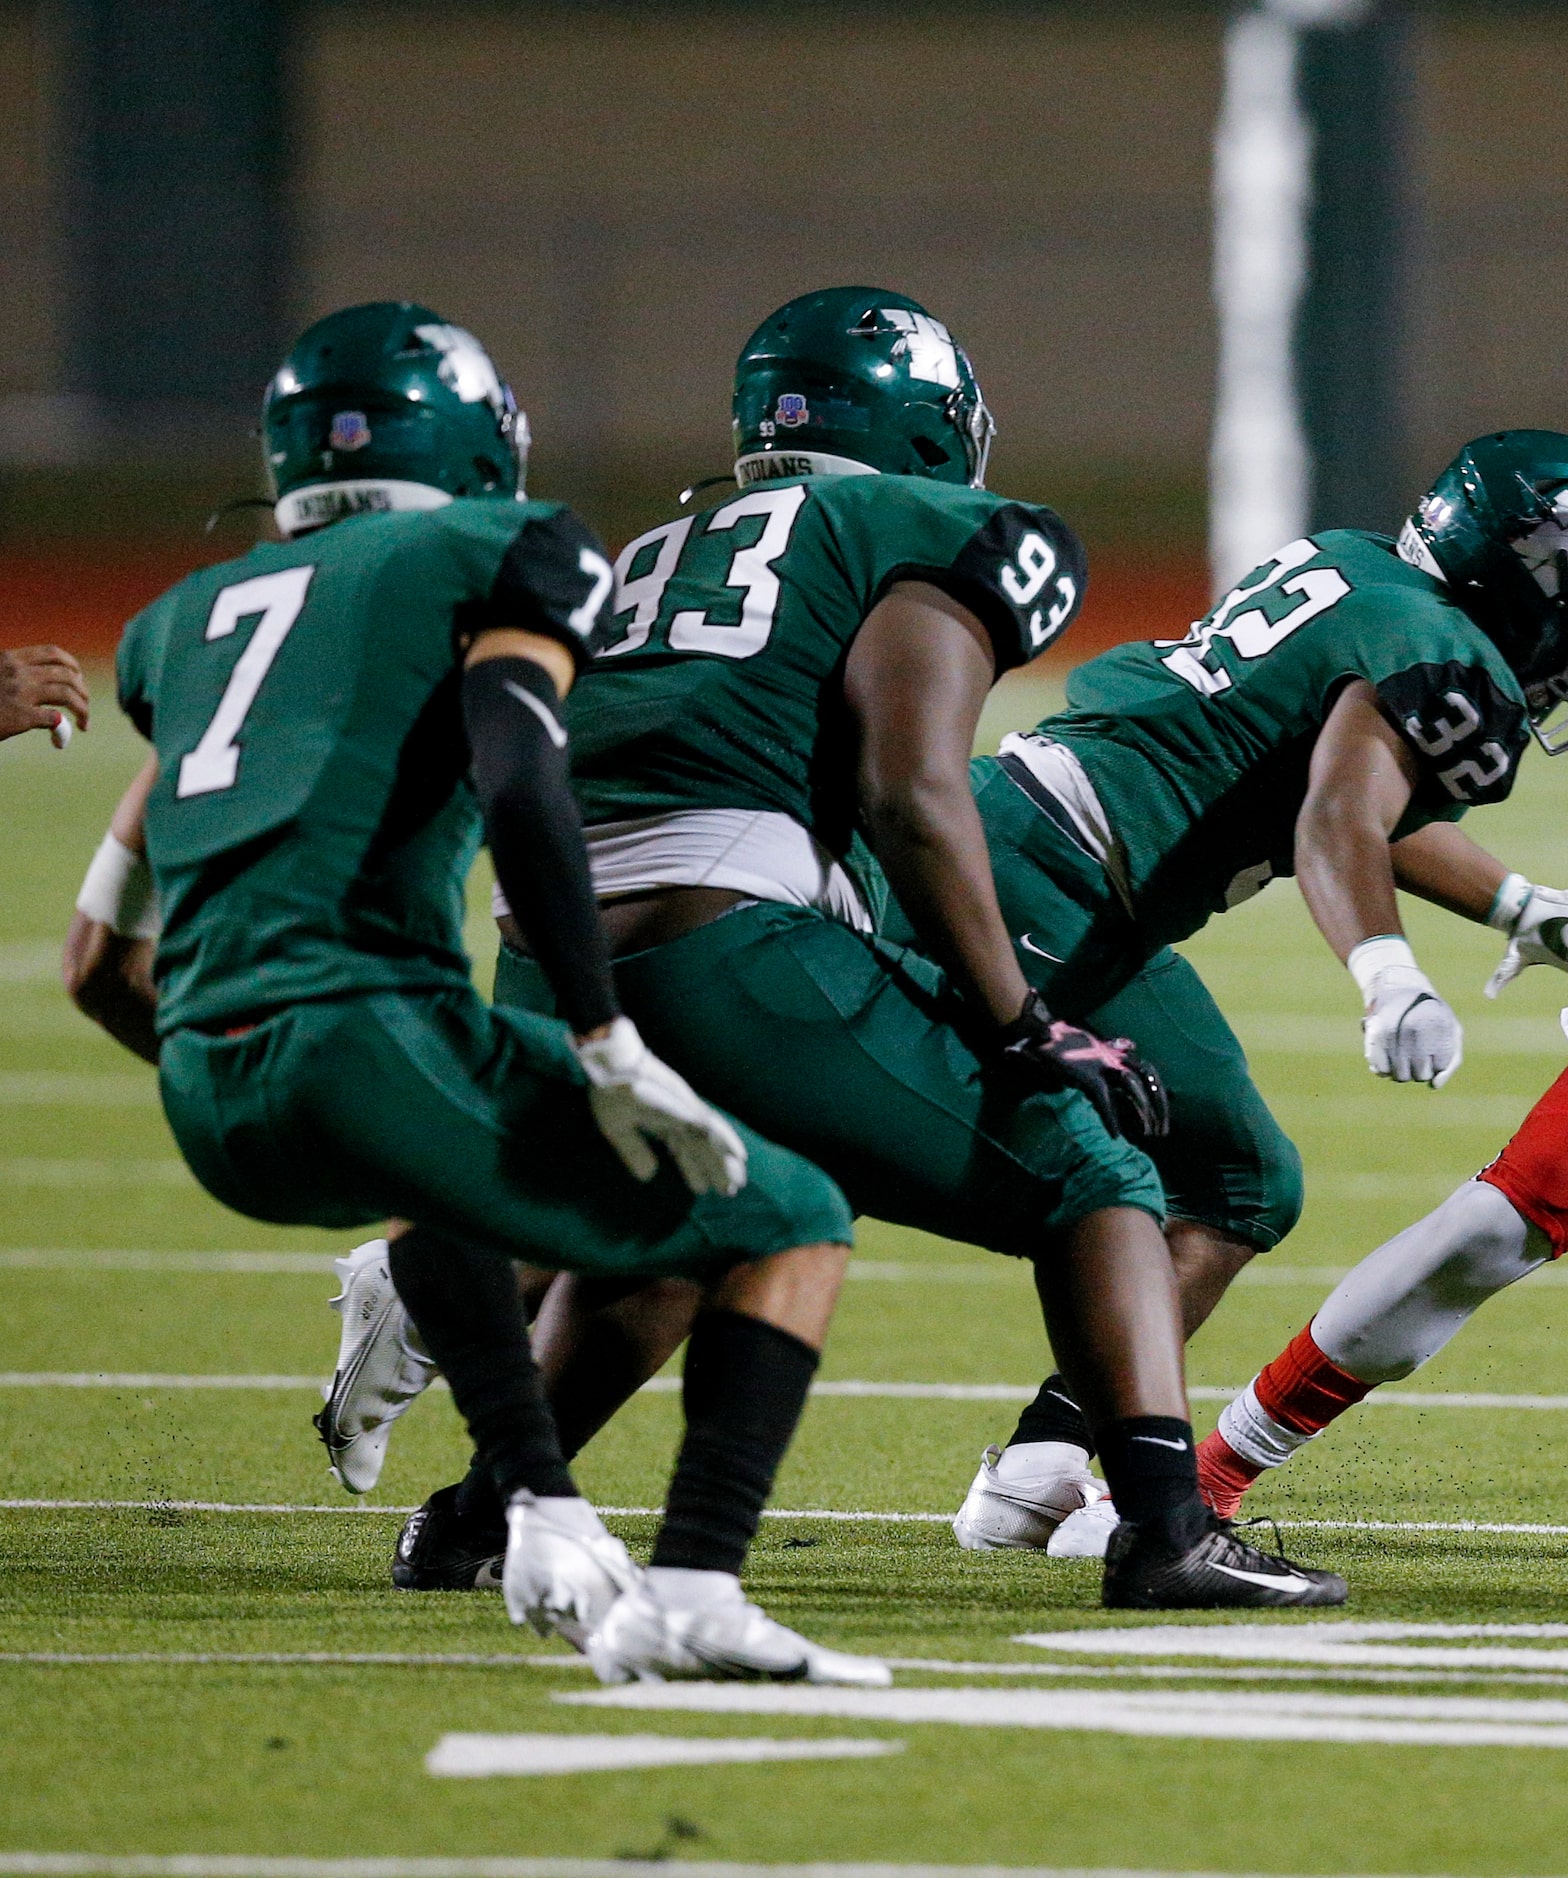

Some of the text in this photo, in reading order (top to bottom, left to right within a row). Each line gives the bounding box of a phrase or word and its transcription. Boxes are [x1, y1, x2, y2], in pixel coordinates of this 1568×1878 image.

[758, 420, 776, 437] 93
[568, 548, 615, 637] 7
[598, 483, 805, 660] 93
[1001, 531, 1077, 647] 93
[176, 564, 315, 799] 7
[1405, 691, 1510, 801] 32
